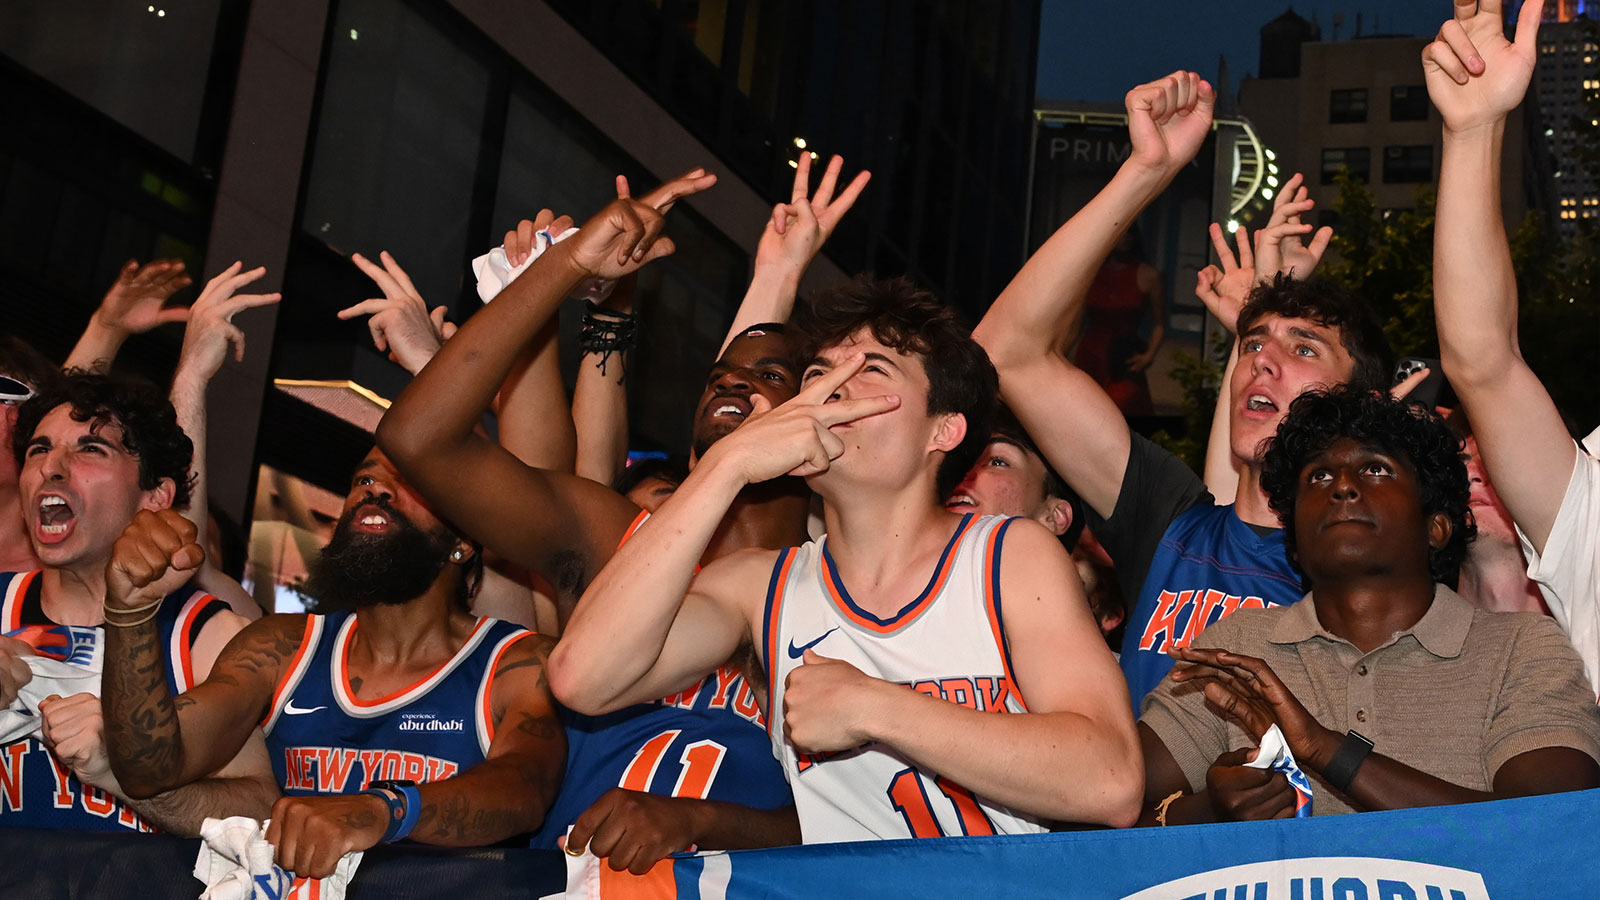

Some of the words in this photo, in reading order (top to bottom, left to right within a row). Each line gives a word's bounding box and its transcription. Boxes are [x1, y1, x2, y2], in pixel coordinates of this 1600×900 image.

[399, 720, 424, 731] abu
[426, 719, 464, 731] dhabi
[285, 746, 357, 793] NEW
[358, 749, 459, 792] YORK
[619, 729, 727, 799] 11
